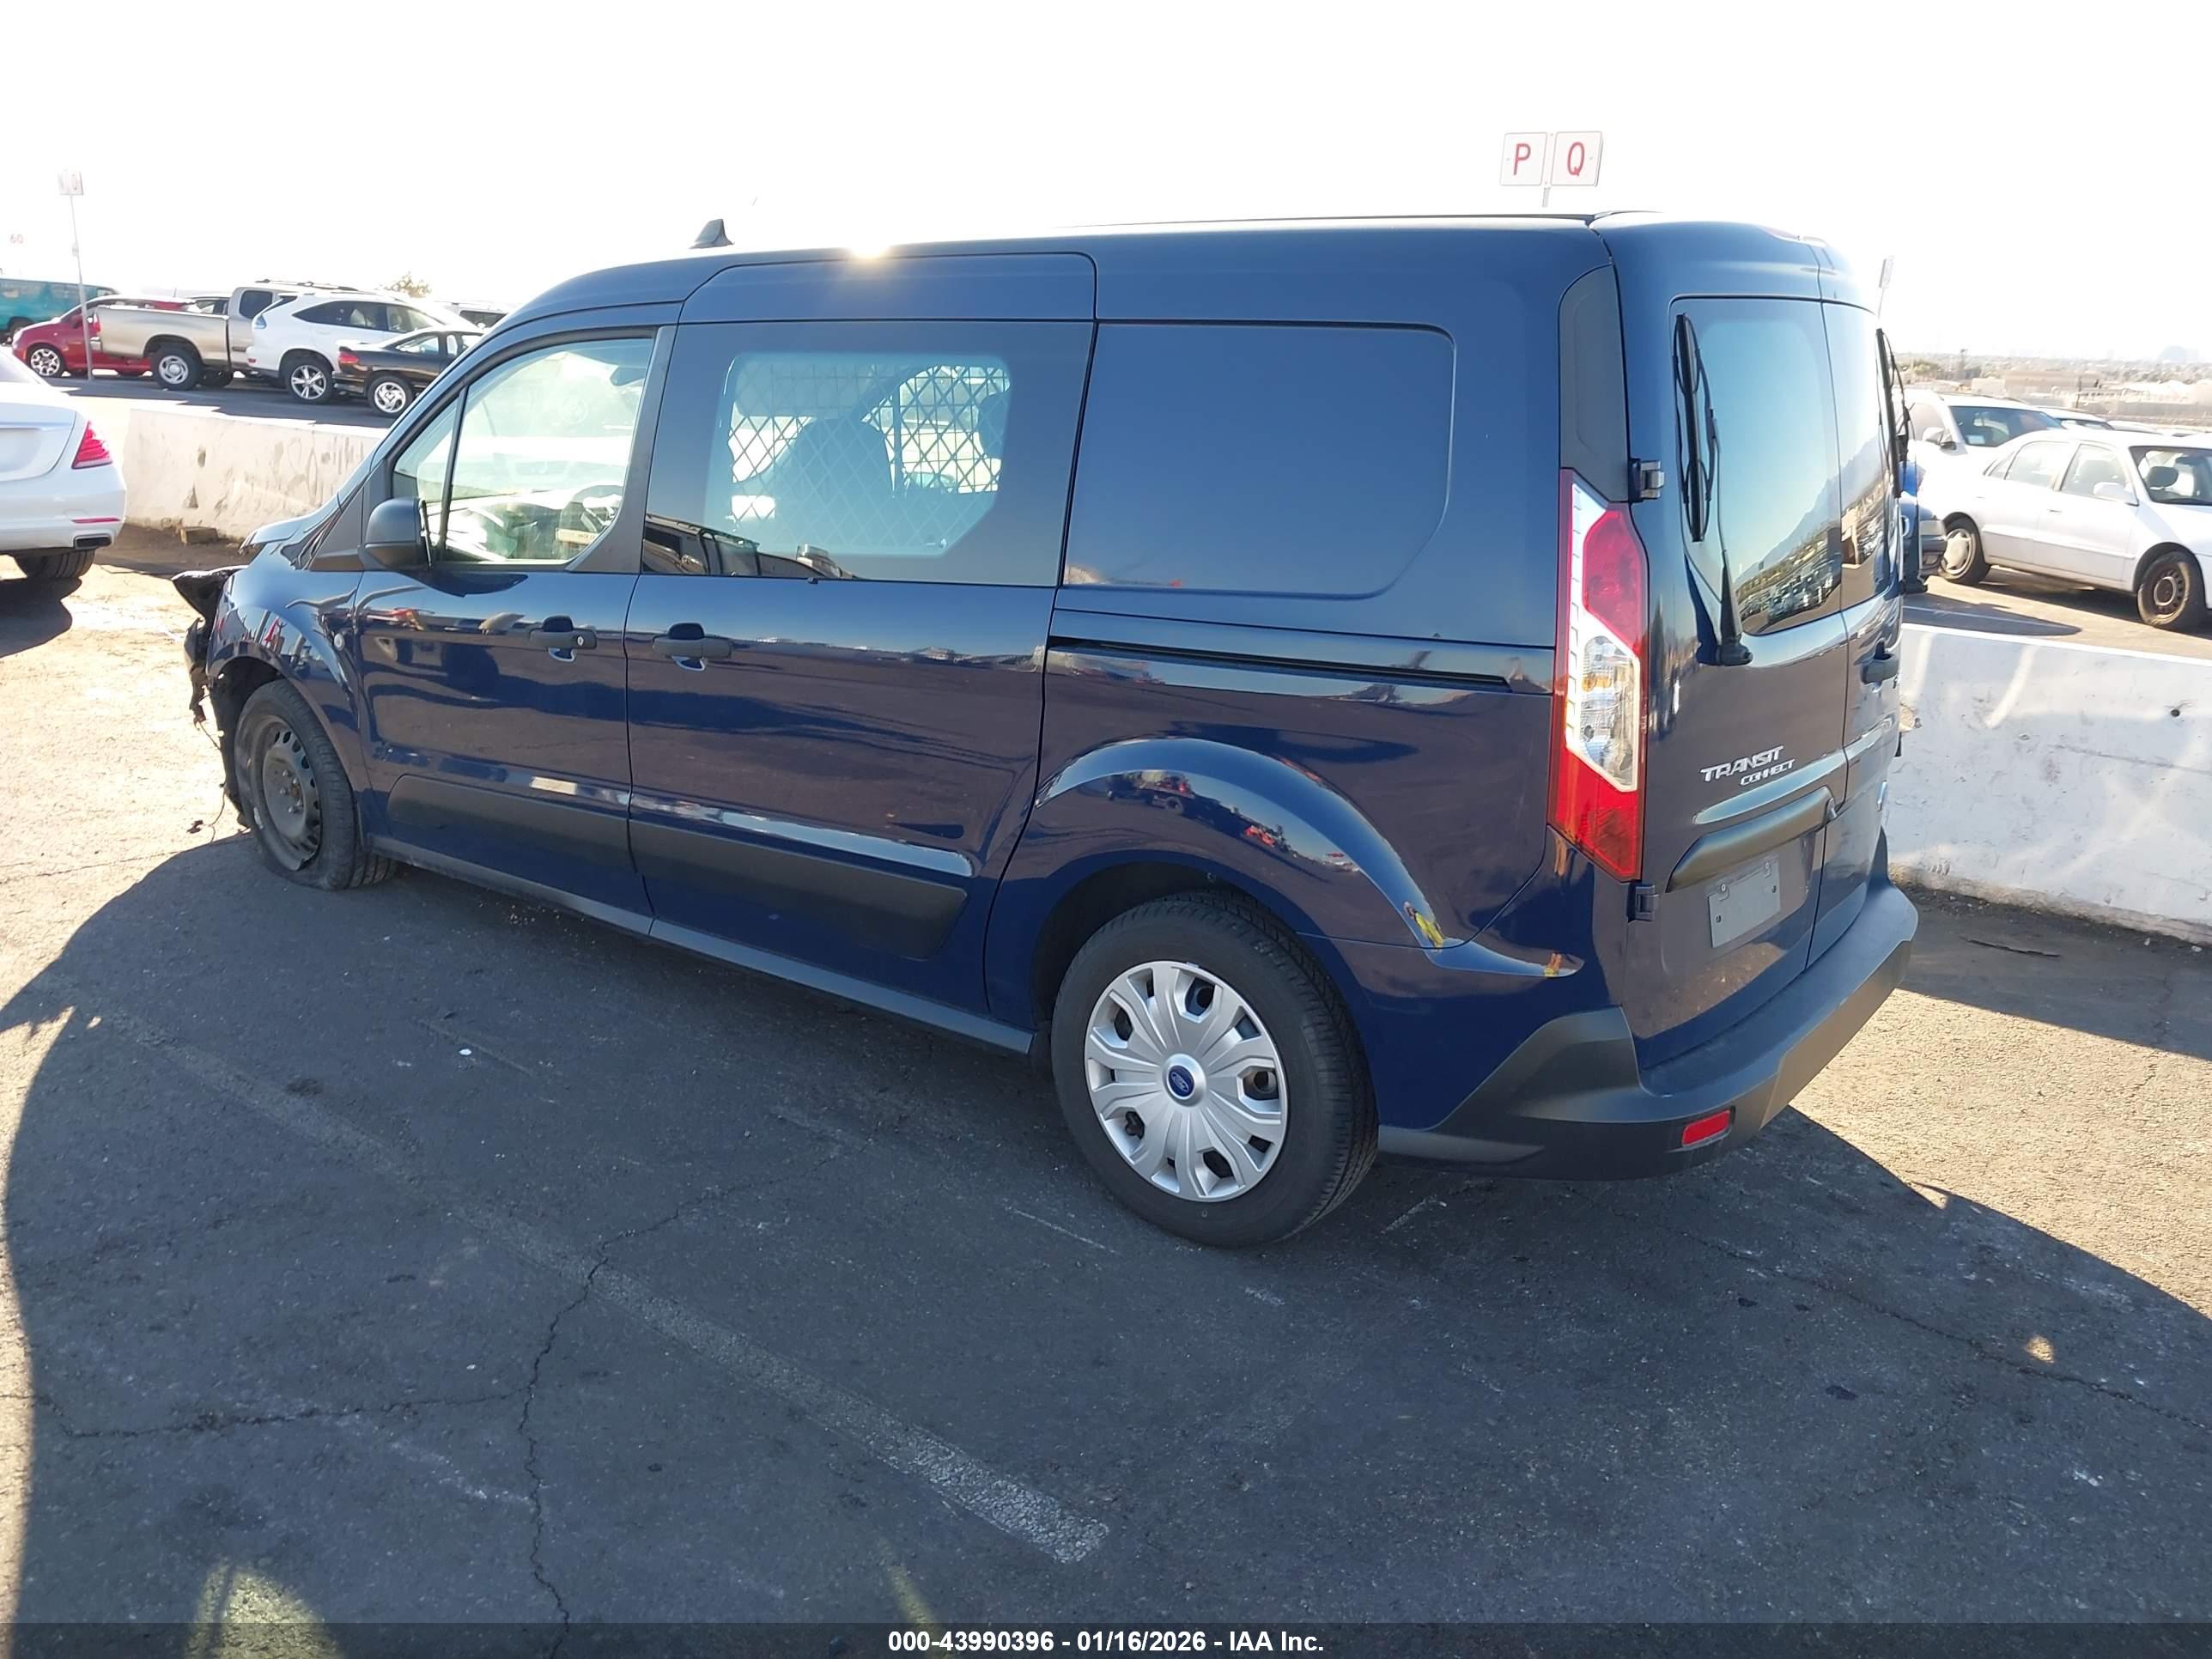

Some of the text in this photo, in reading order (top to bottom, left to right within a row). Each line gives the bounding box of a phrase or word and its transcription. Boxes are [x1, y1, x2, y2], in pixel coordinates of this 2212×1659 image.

[1513, 142, 1585, 176] P Q
[1699, 745, 1784, 782] TRANSIT
[1740, 758, 1796, 786] CONNECT
